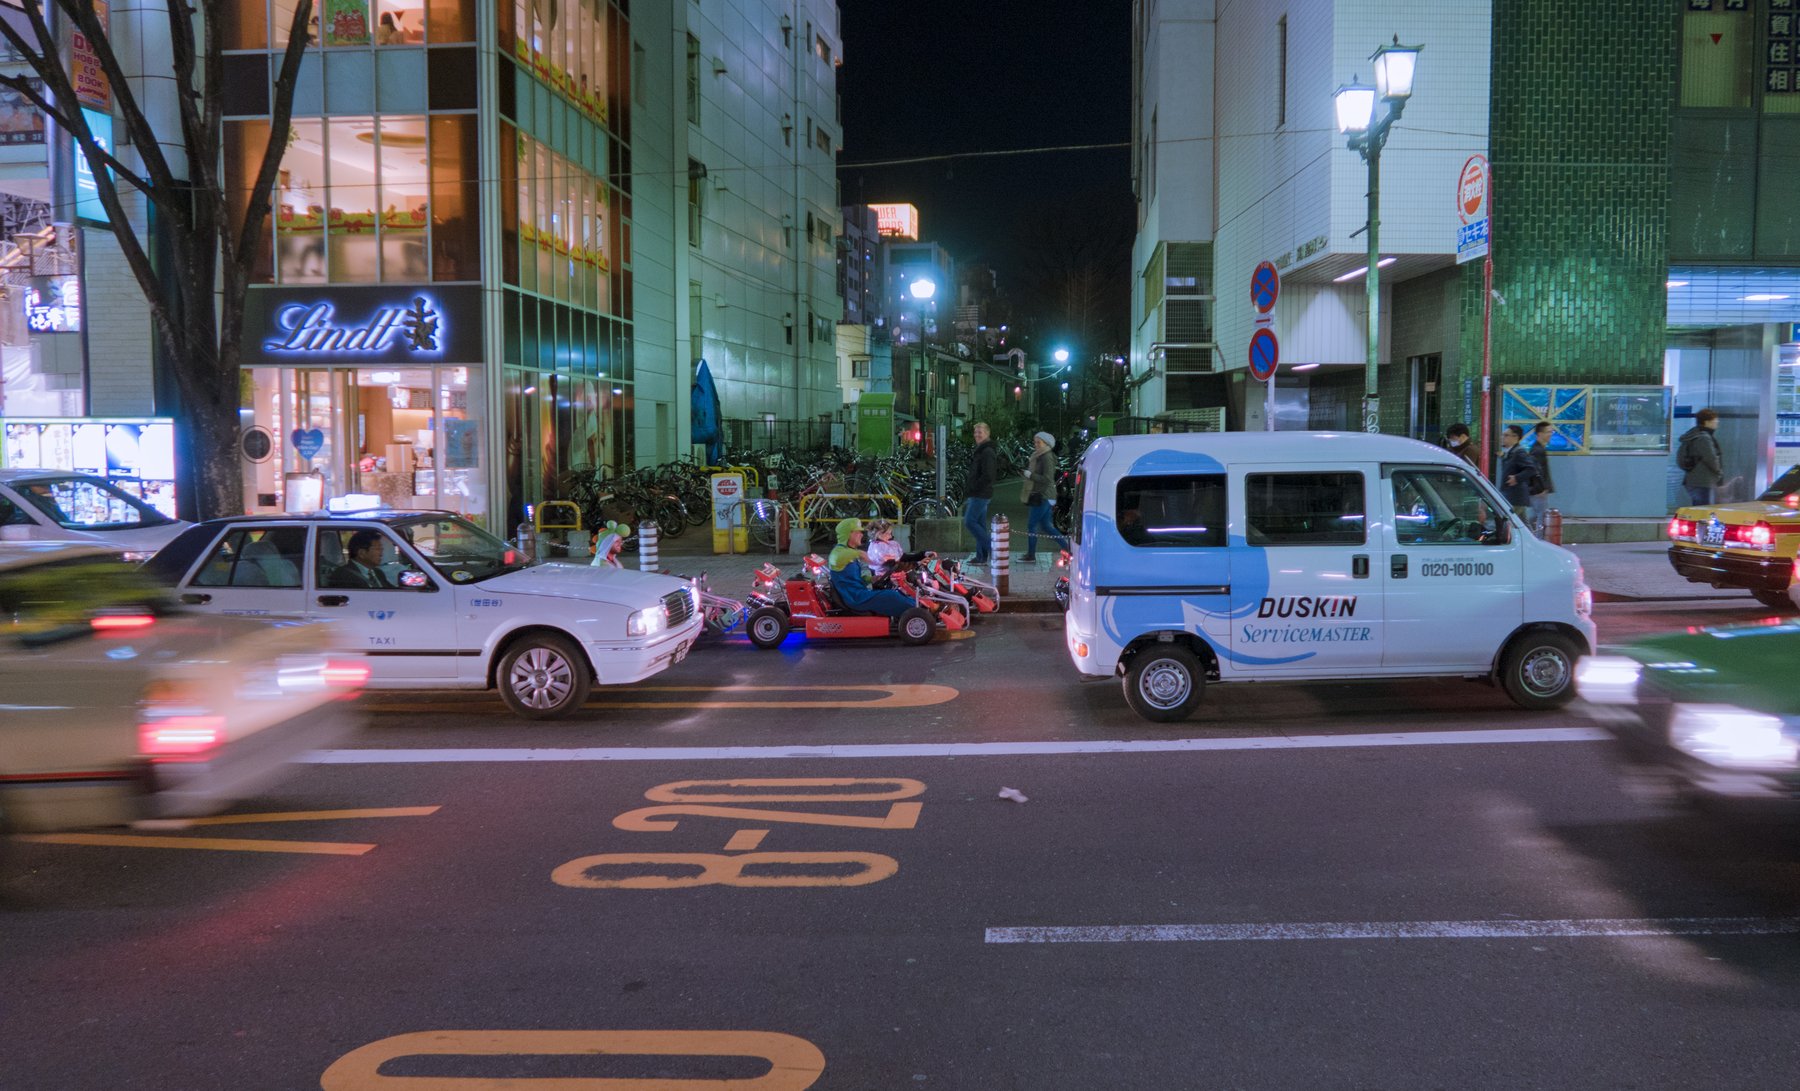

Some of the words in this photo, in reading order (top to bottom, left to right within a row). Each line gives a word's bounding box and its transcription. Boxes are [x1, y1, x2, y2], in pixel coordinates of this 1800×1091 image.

[74, 52, 100, 66] HOBB
[78, 74, 103, 88] BOOK
[263, 303, 406, 351] Lindt
[1422, 563, 1494, 576] 0120-100100
[1257, 596, 1357, 618] DUSKIN
[1240, 623, 1371, 643] ServiceMASTER
[369, 637, 395, 645] TAXI
